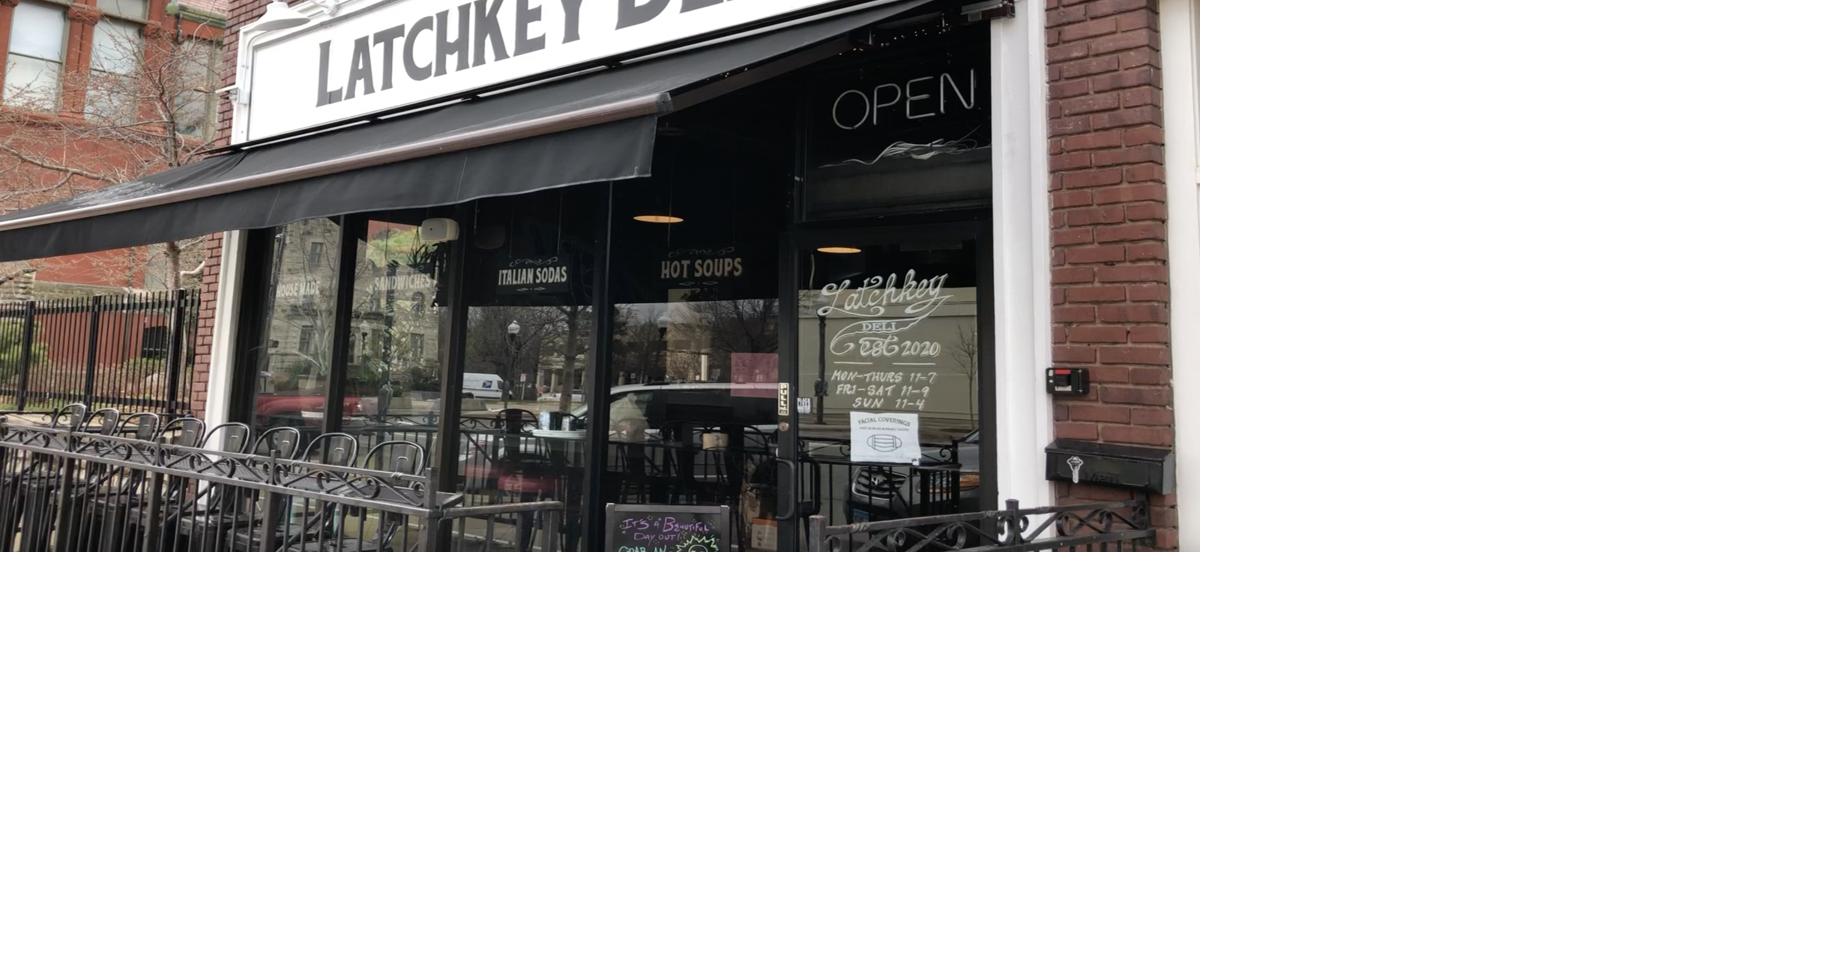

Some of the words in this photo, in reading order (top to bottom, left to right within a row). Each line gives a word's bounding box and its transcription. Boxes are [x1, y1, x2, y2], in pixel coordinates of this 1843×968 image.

[316, 0, 585, 107] LATCHKEY
[832, 68, 976, 130] OPEN
[497, 267, 534, 286] ITALIAN
[535, 265, 568, 284] SODAS
[660, 260, 690, 279] HOT
[694, 257, 743, 277] SOUPS
[275, 282, 299, 297] HOUSE
[300, 281, 320, 296] MADE
[374, 274, 431, 291] SANDWICHES
[817, 269, 953, 317] Latchkey
[861, 321, 897, 332] DELI
[901, 340, 941, 357] 2020
[909, 371, 938, 385] 11-7
[780, 383, 788, 406] PULL
[901, 385, 930, 398] 11-9
[852, 397, 884, 409] SUN
[895, 398, 925, 411] 11-4
[857, 416, 877, 426] FACIAL
[877, 416, 911, 427] COVERINGS
[633, 532, 656, 546] DAY
